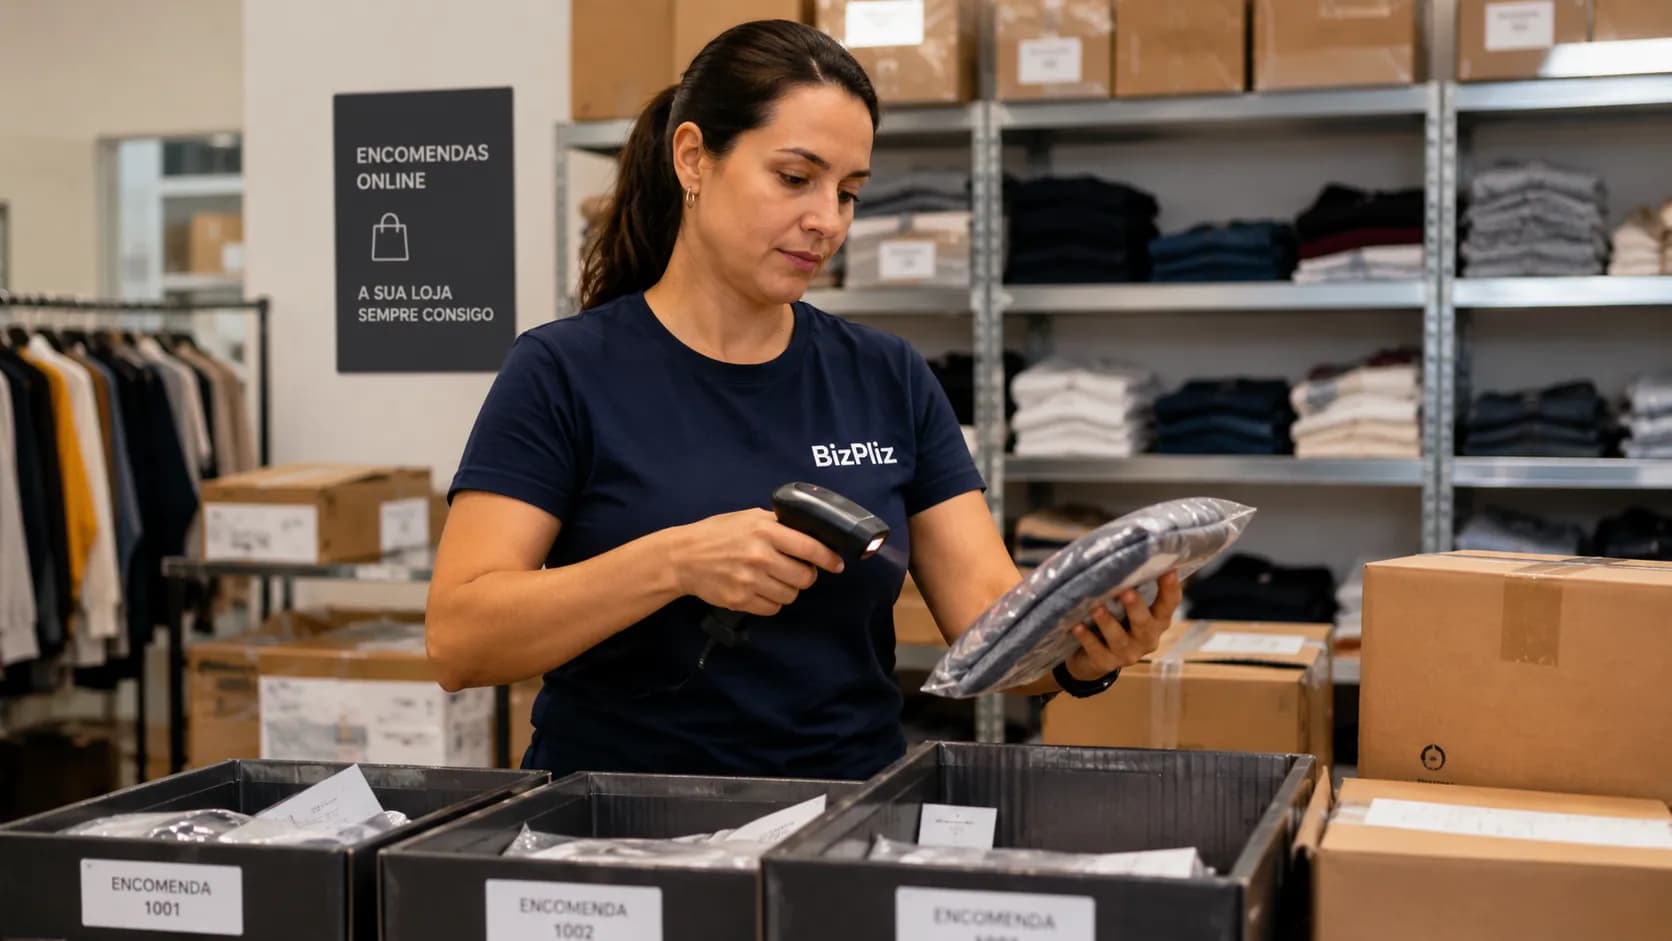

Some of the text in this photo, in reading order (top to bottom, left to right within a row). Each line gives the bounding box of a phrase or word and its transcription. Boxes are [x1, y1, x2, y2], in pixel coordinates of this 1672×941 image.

[356, 144, 489, 163] ENCOMENDAS
[356, 172, 426, 189] ONLINE
[358, 285, 453, 300] A SUA LOJA
[358, 307, 494, 322] SEMPRE CONSIGO
[811, 441, 898, 468] BizPliz
[111, 876, 212, 896] ENCOMENDA
[144, 901, 181, 918] 1001
[519, 898, 628, 917] ENCOMENDA
[934, 907, 1055, 930] ENCOMENDA
[554, 923, 594, 940] 1002
